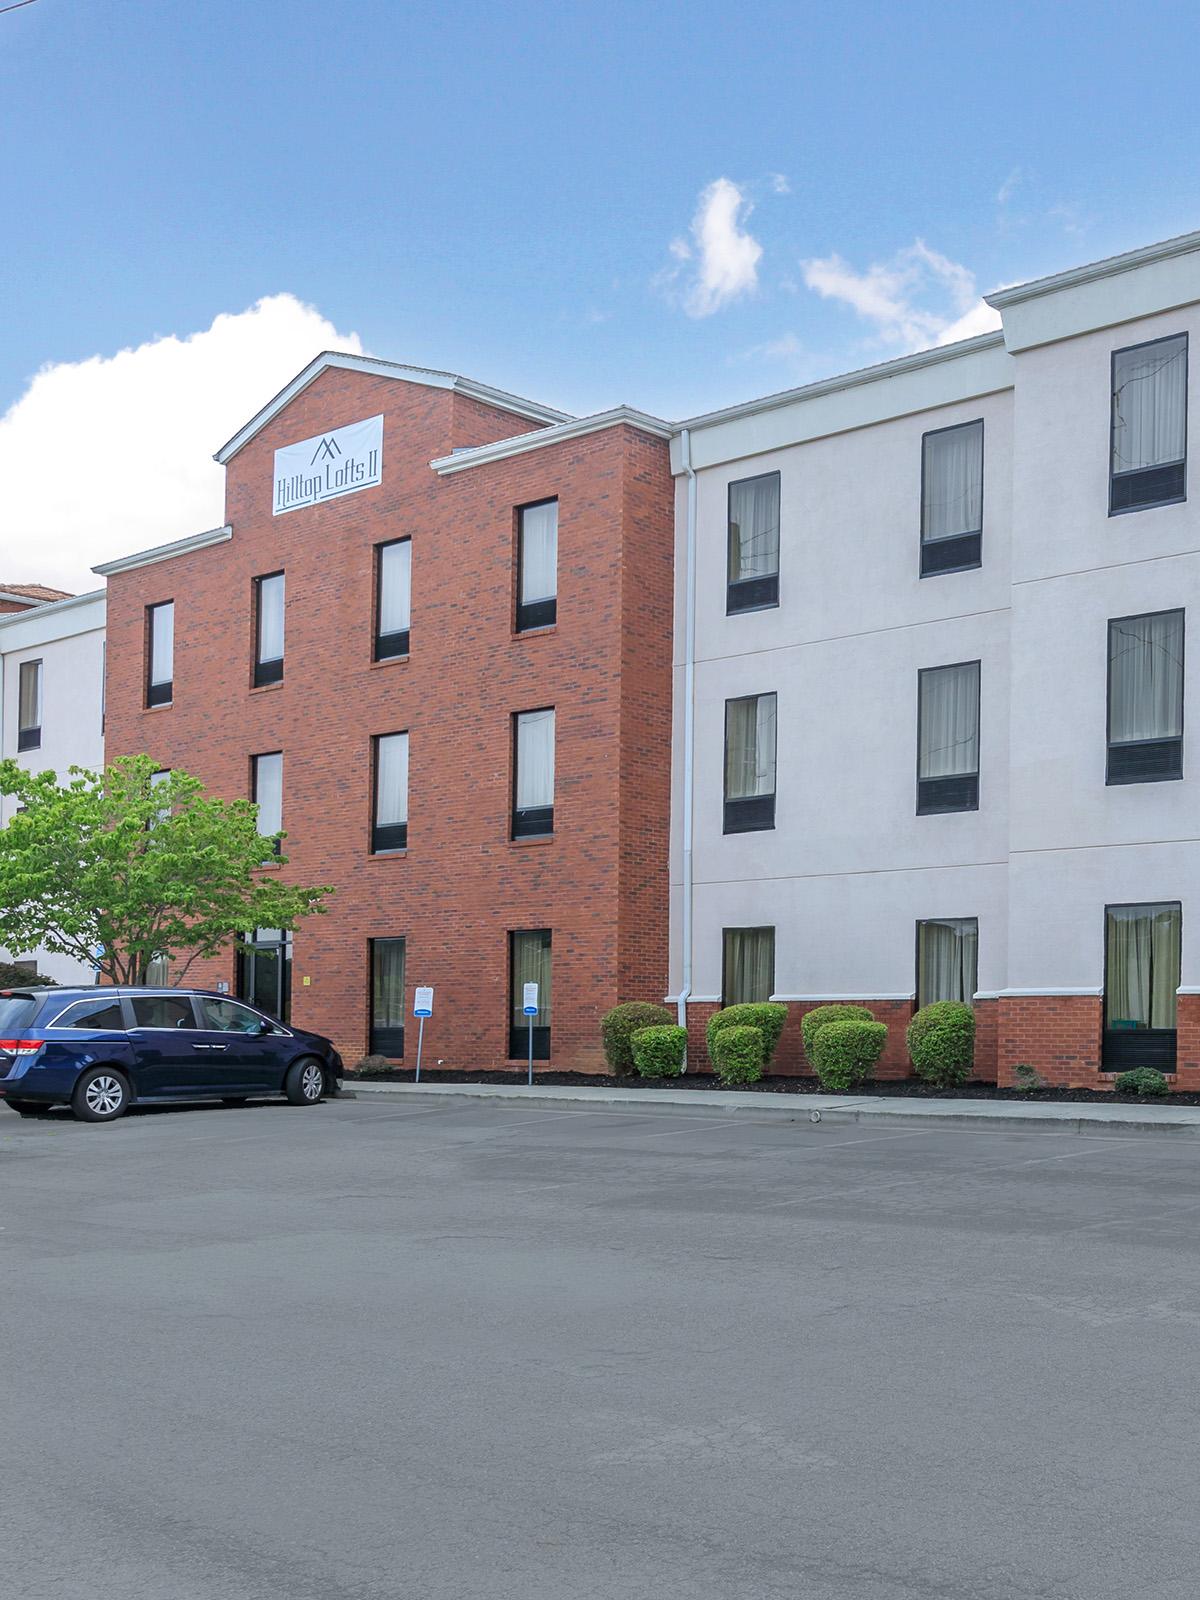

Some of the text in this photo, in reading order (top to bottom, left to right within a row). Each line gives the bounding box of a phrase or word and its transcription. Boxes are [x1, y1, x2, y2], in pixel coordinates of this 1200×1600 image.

[278, 449, 378, 507] Hilltop Lofts II
